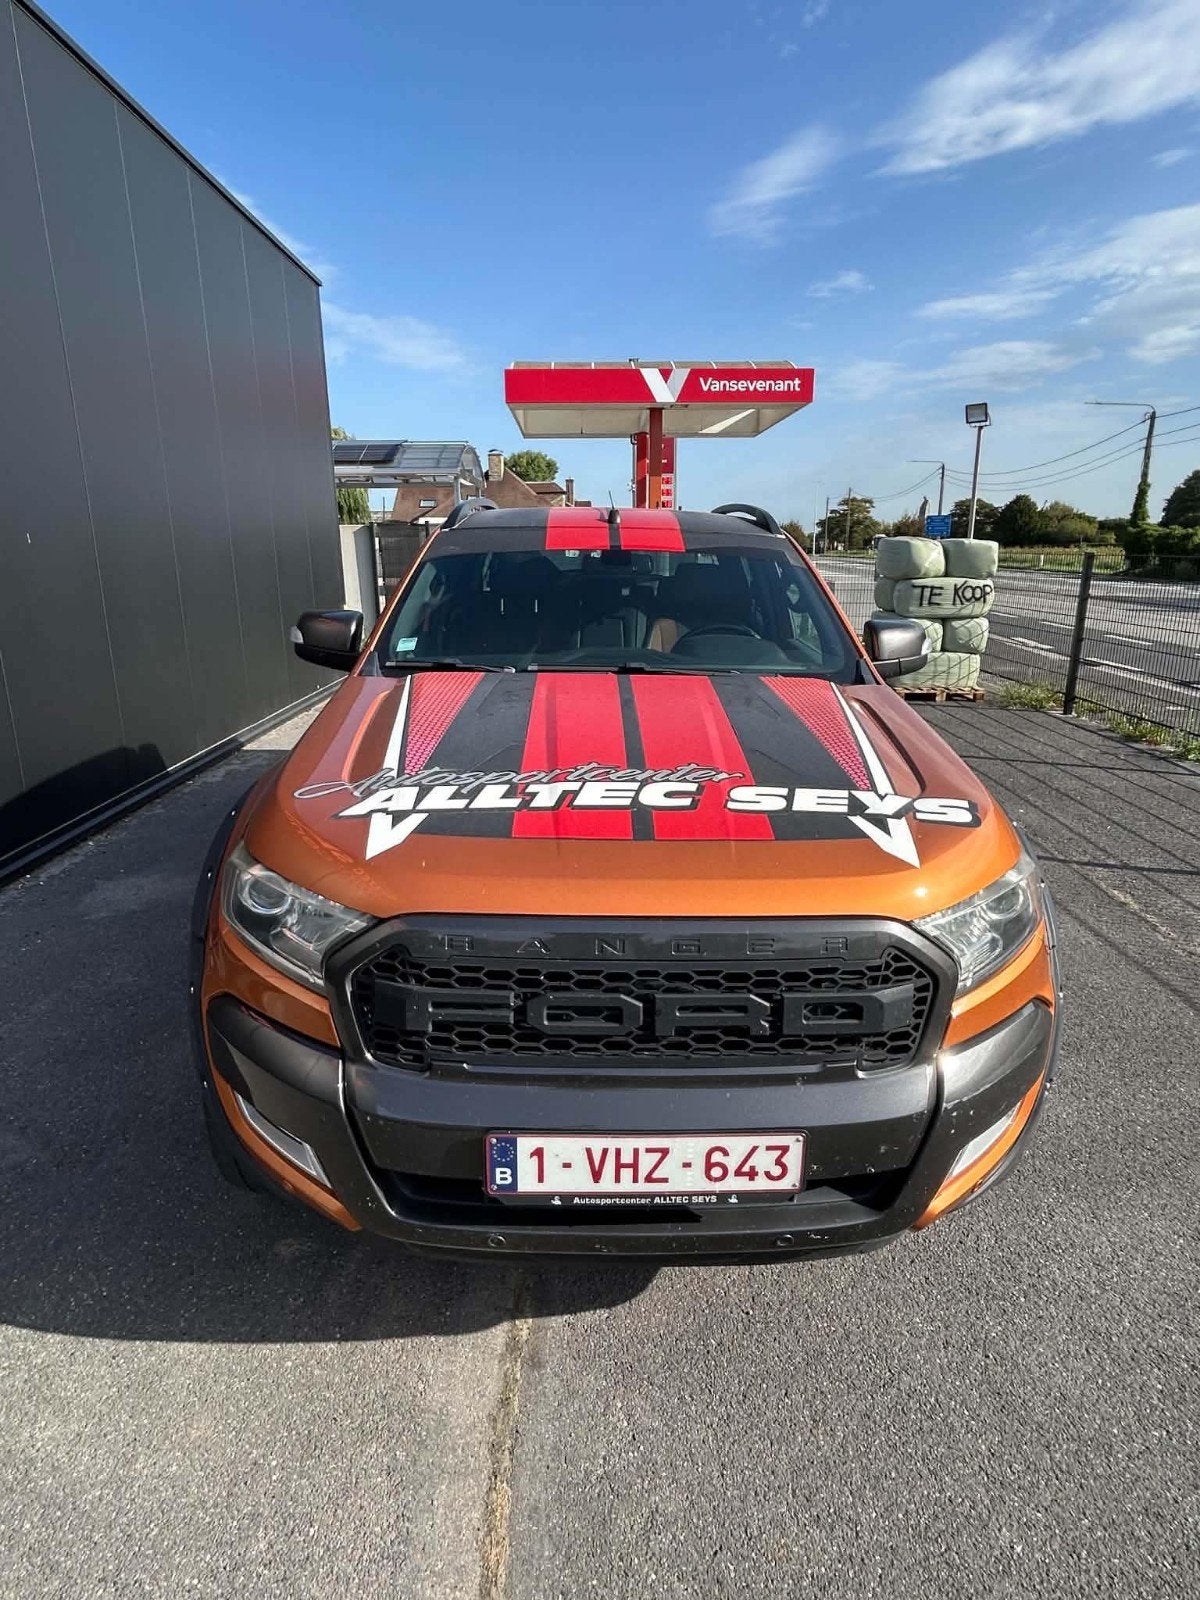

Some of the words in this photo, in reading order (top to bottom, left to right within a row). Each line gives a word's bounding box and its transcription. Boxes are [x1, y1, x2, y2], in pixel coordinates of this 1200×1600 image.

[699, 377, 802, 392] Vansevenant
[911, 584, 944, 607] TE
[952, 580, 993, 606] KOOP
[293, 761, 745, 800] Autosportcenter
[336, 780, 701, 819] ALLTEC
[725, 784, 981, 828] SEYS
[443, 933, 850, 956] RANGER
[374, 978, 914, 1037] FORD
[494, 1167, 513, 1185] B
[573, 1196, 651, 1206] Autosportcenter
[653, 1196, 689, 1205] ALLTEC
[691, 1195, 718, 1204] SEYS
